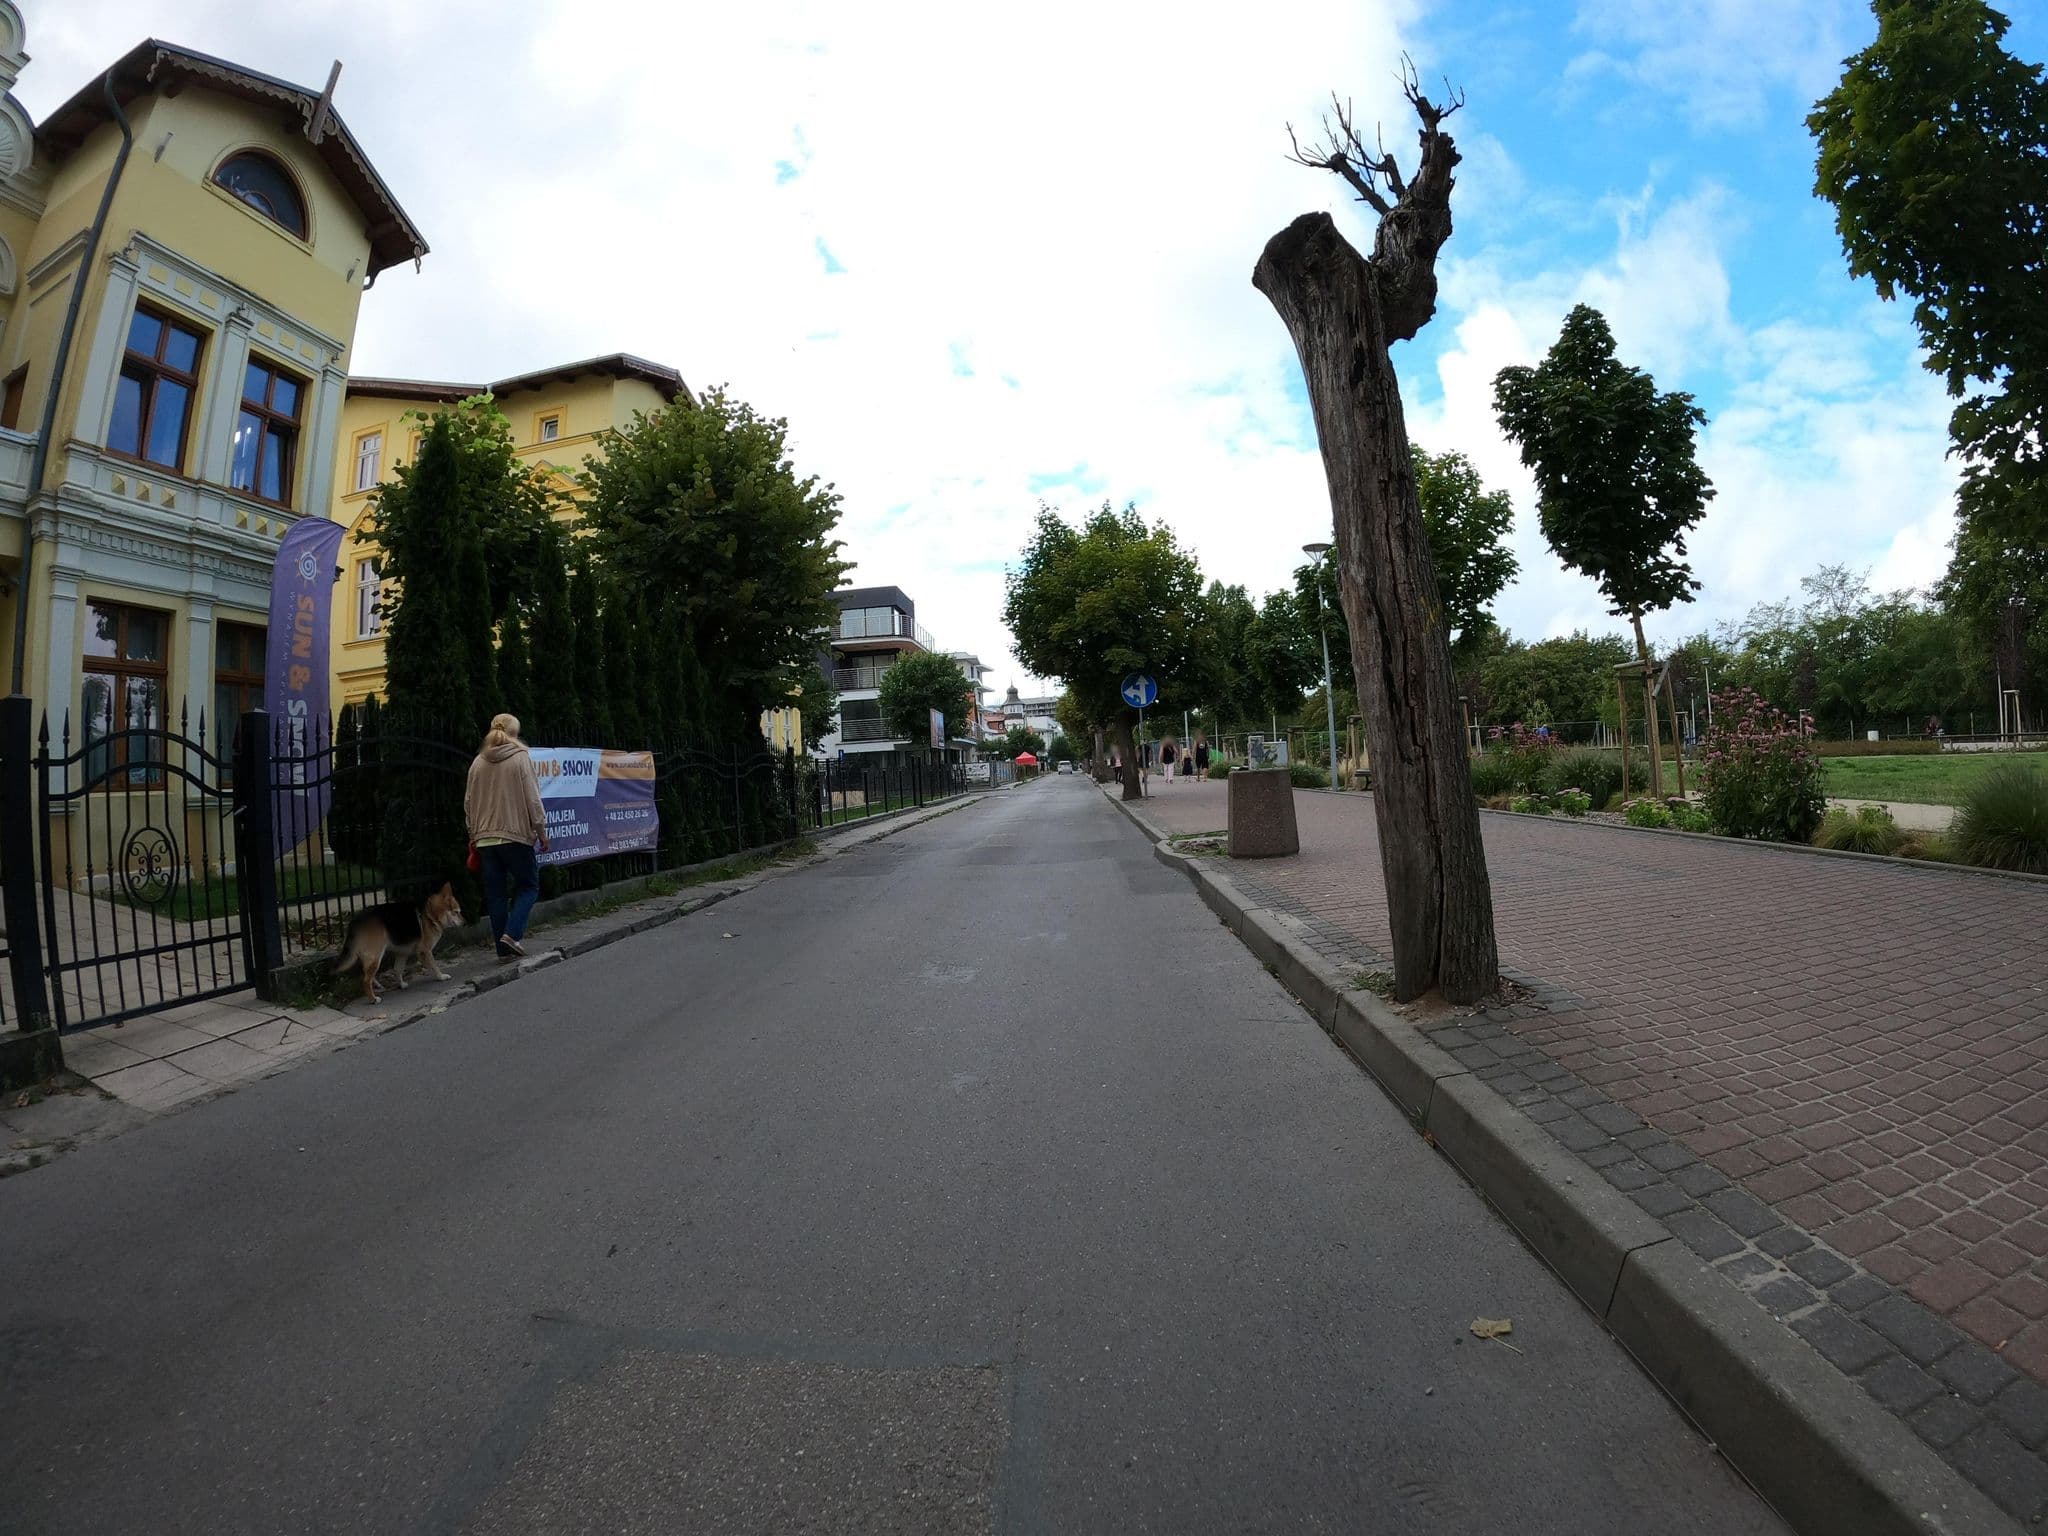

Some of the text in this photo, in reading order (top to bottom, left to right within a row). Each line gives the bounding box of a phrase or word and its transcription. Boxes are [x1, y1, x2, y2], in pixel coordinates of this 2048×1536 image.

[287, 594, 315, 797] SUN & SNOW
[533, 760, 593, 777] UN & SNOW
[545, 809, 576, 824] YNAJEM
[544, 821, 589, 839] TAMENTÓW
